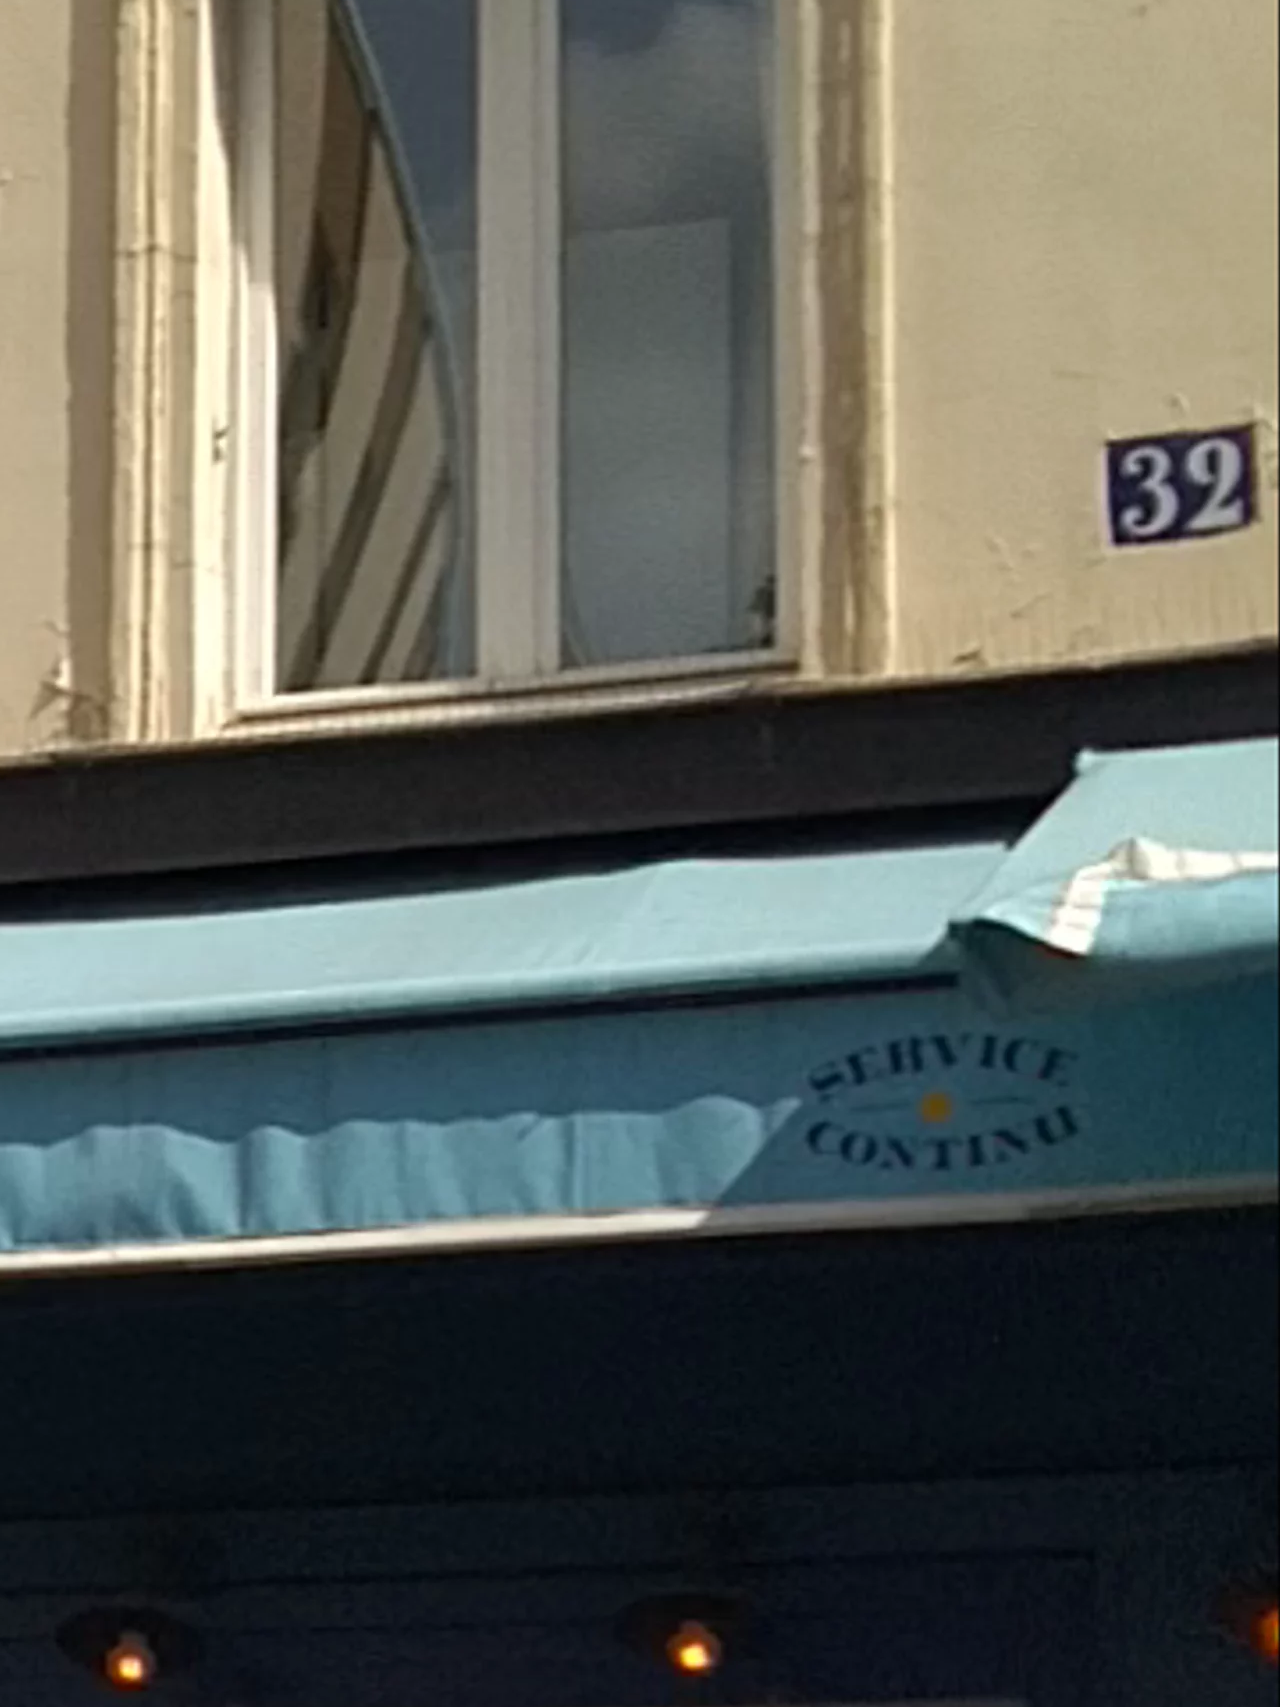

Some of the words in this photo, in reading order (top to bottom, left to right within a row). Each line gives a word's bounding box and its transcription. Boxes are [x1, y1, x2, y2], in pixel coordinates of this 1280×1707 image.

[1118, 437, 1244, 536] 32
[806, 1031, 1080, 1104] SERVICE
[805, 1105, 1079, 1171] CONTINU
